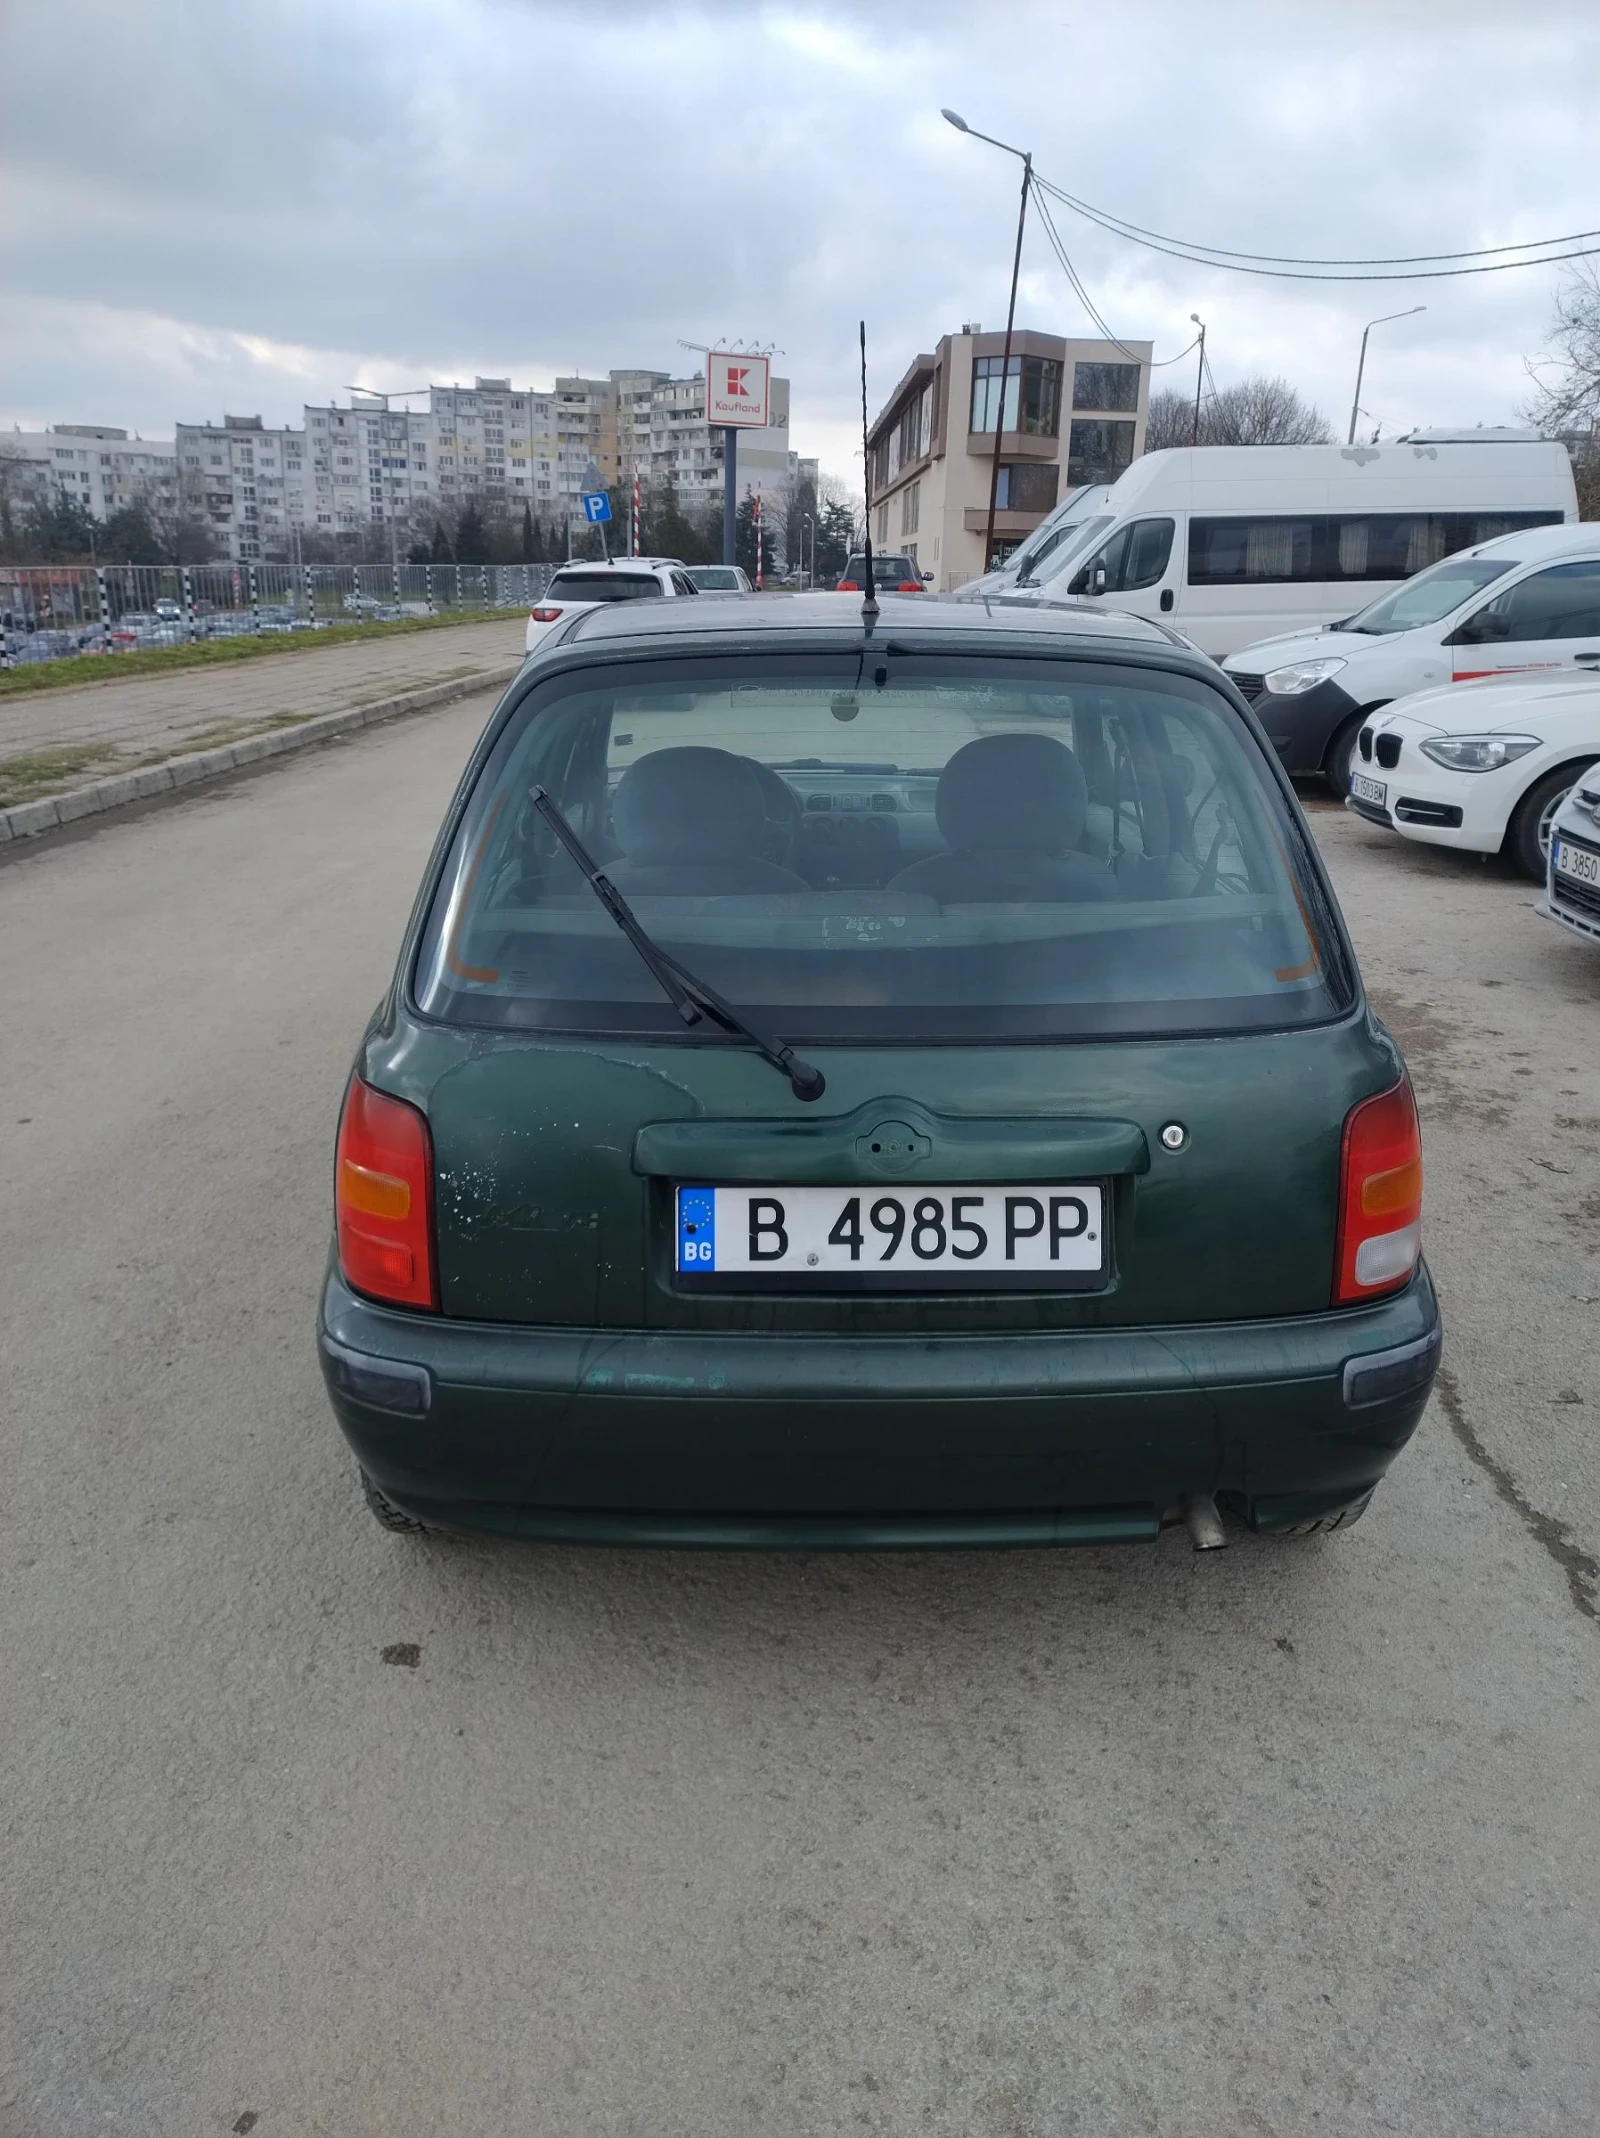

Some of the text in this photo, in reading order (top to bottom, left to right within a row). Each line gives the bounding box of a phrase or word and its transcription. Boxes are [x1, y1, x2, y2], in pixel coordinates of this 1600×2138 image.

[715, 400, 761, 413] Kaufland
[588, 496, 604, 520] P
[1561, 846, 1598, 881] B 3850
[748, 1196, 1089, 1261] B 4985 PP
[684, 1242, 712, 1261] BG
